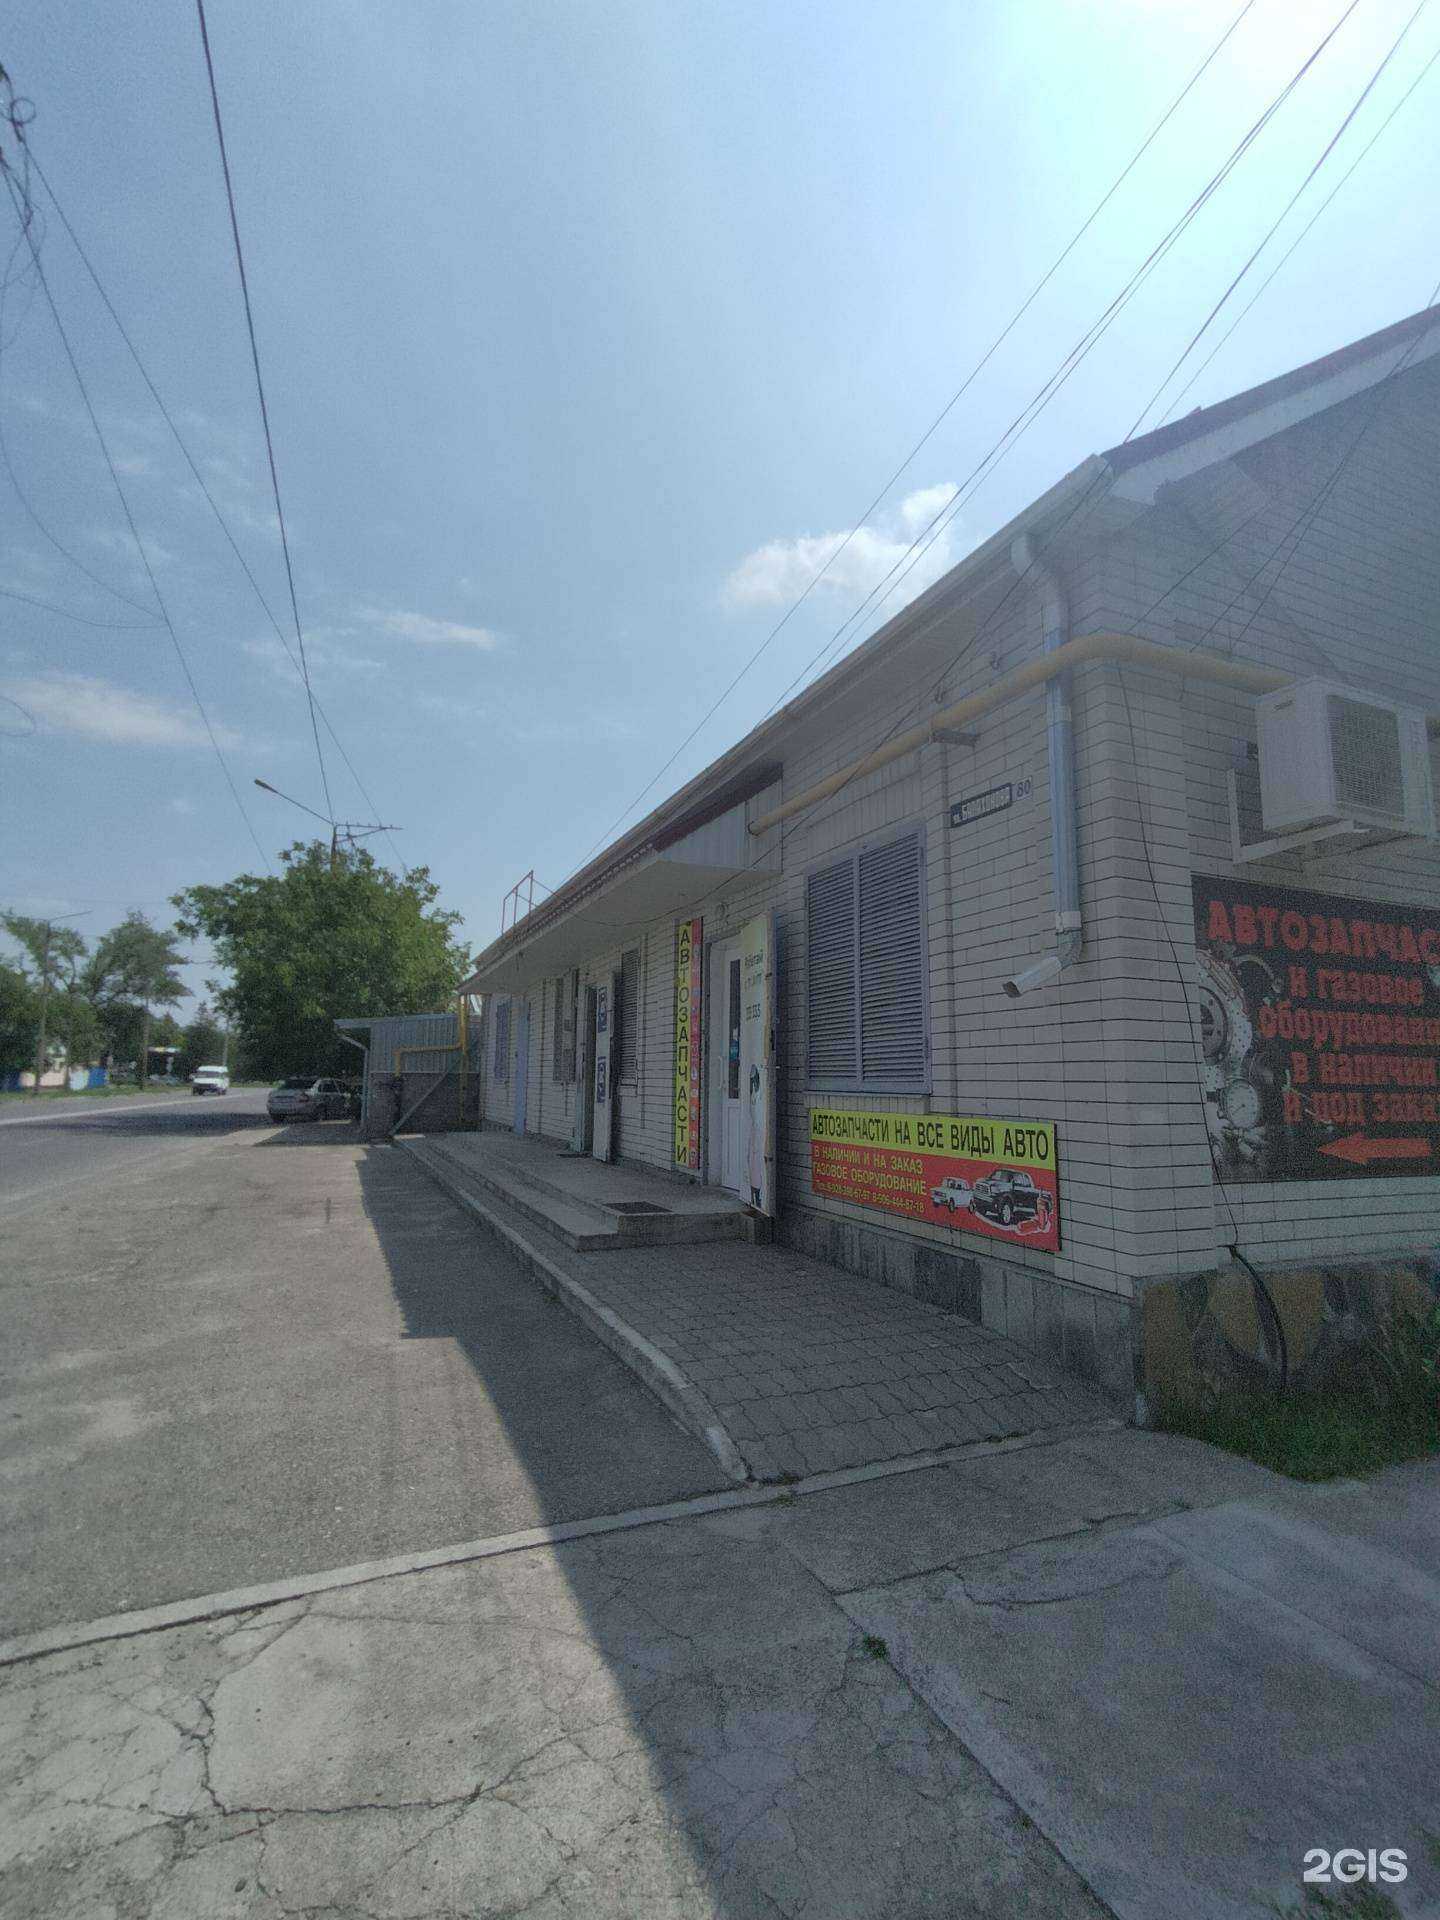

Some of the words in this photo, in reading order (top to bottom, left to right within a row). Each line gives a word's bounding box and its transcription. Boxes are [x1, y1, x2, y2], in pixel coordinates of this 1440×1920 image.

[677, 929, 690, 1163] АВТОЗАПЧАСТИ
[812, 1114, 890, 1143] АВТОЗАПЧАСТИ
[895, 1120, 911, 1145] НА
[917, 1121, 944, 1149] ВСЕ
[950, 1124, 994, 1157] ВИДЫ
[1003, 1129, 1048, 1160] АВТО
[813, 1161, 848, 1180] ГАЗОВОЕ
[850, 1168, 927, 1196] ОБОРУДОВАНИЕ
[863, 1151, 870, 1165] И
[873, 1153, 887, 1169] НА
[890, 1156, 923, 1175] ЗАКАЗ
